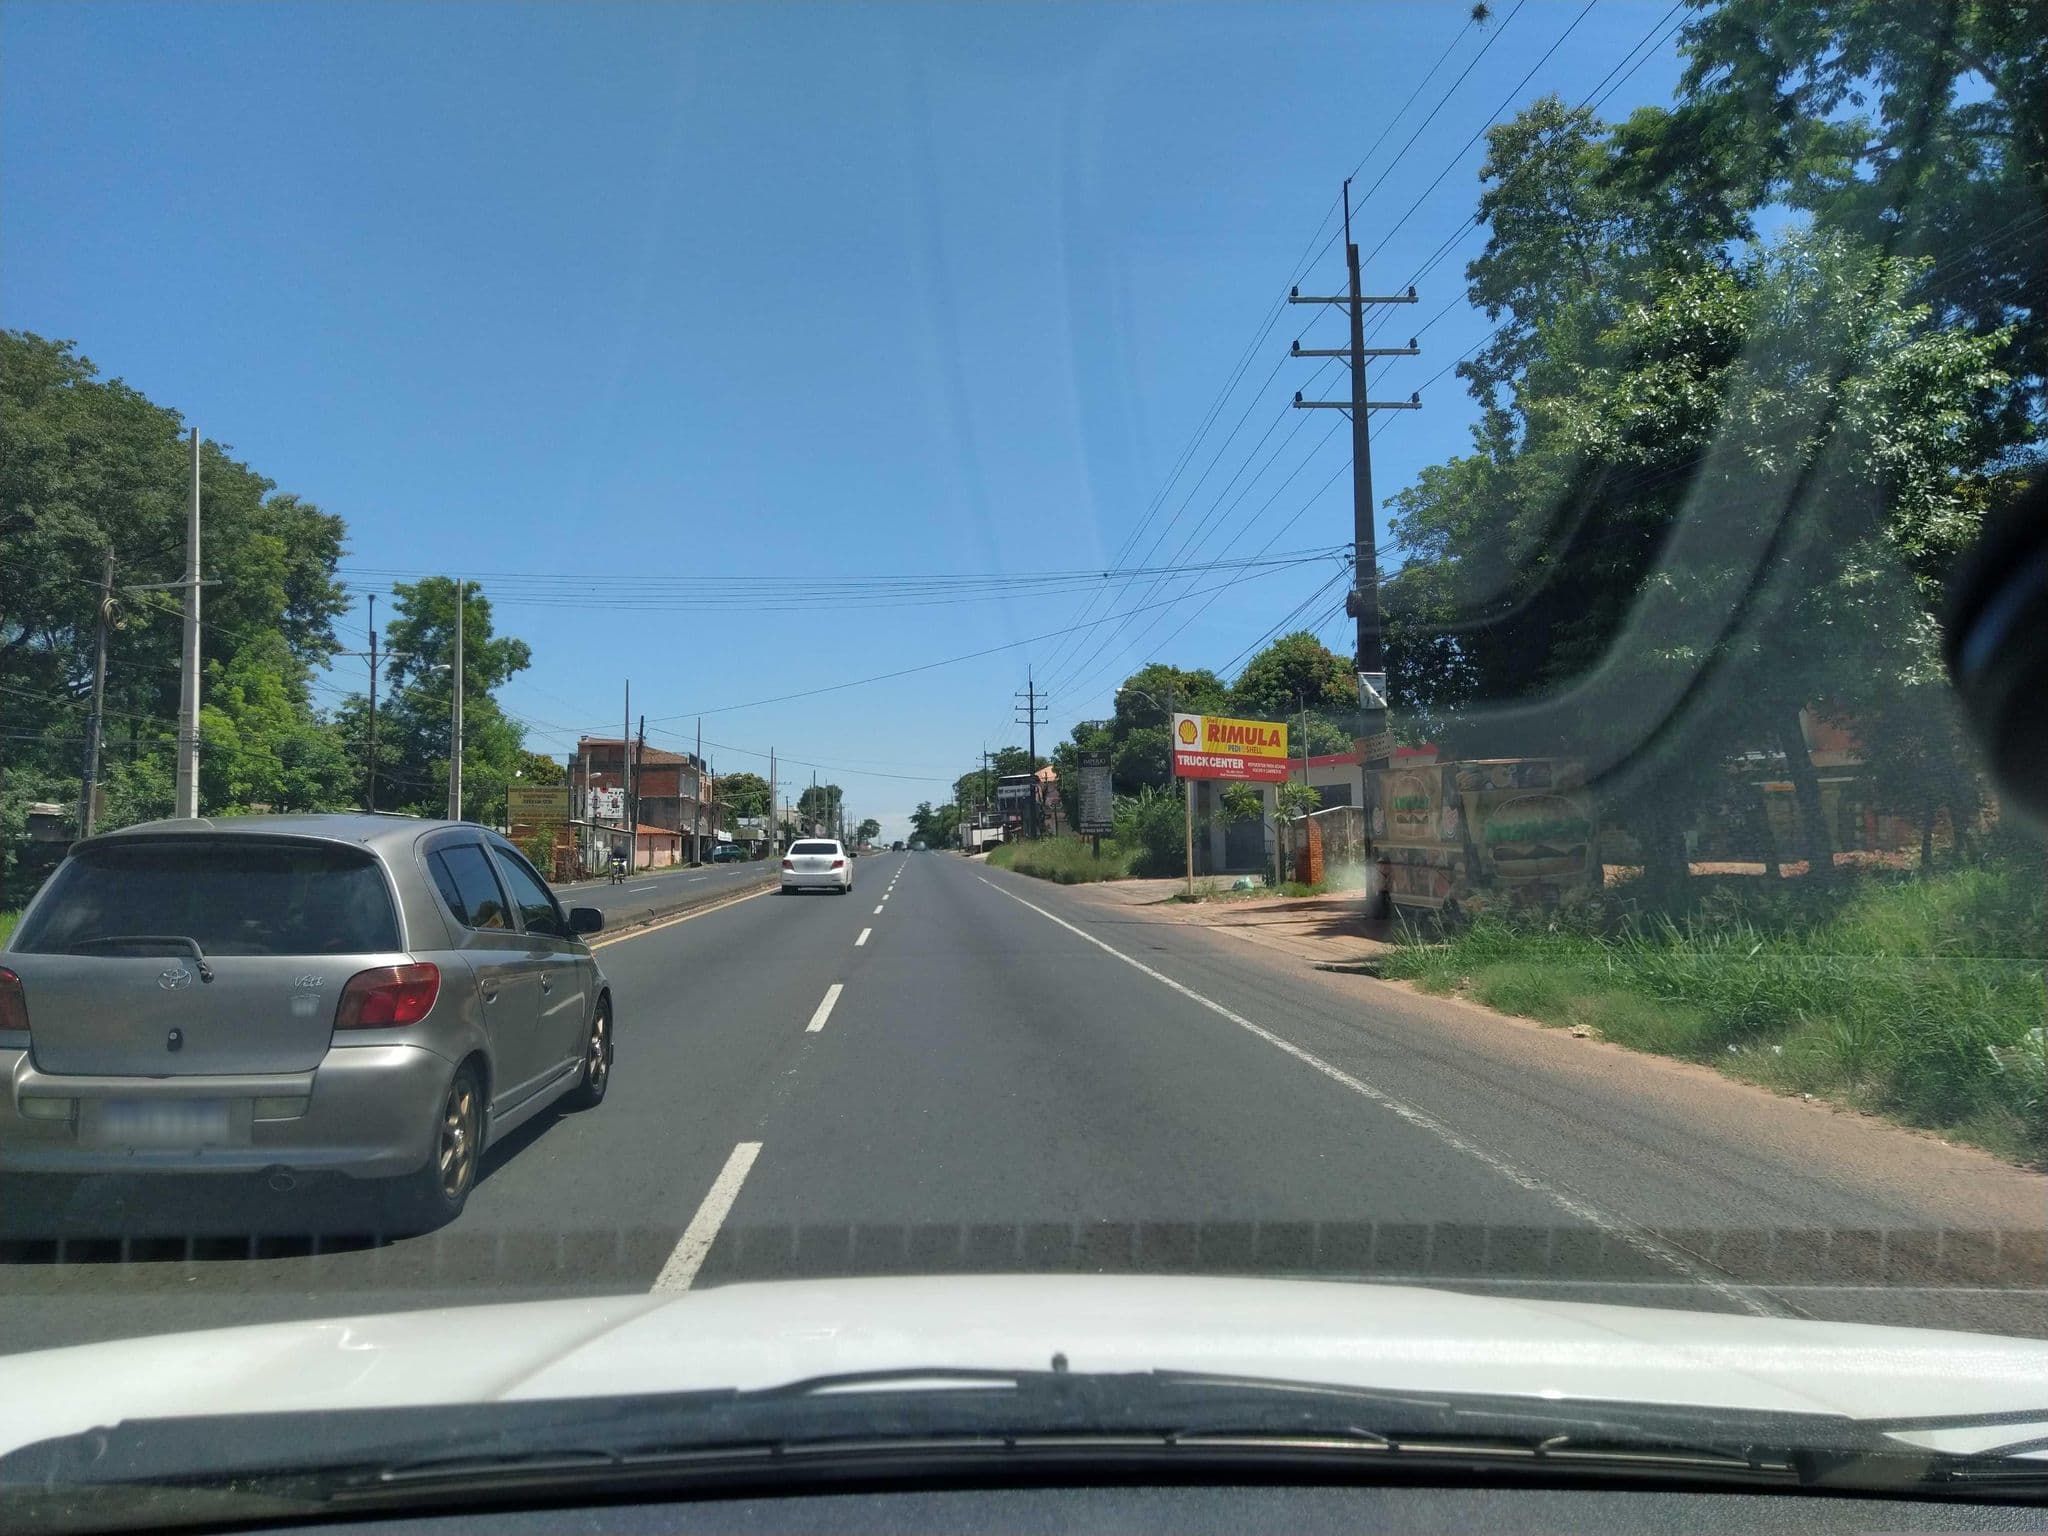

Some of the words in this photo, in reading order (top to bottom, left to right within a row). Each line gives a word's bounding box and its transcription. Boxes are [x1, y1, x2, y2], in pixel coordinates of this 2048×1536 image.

[1207, 724, 1281, 746] RIMULA
[1177, 755, 1209, 767] TRUCK
[1209, 757, 1244, 769] CENTER
